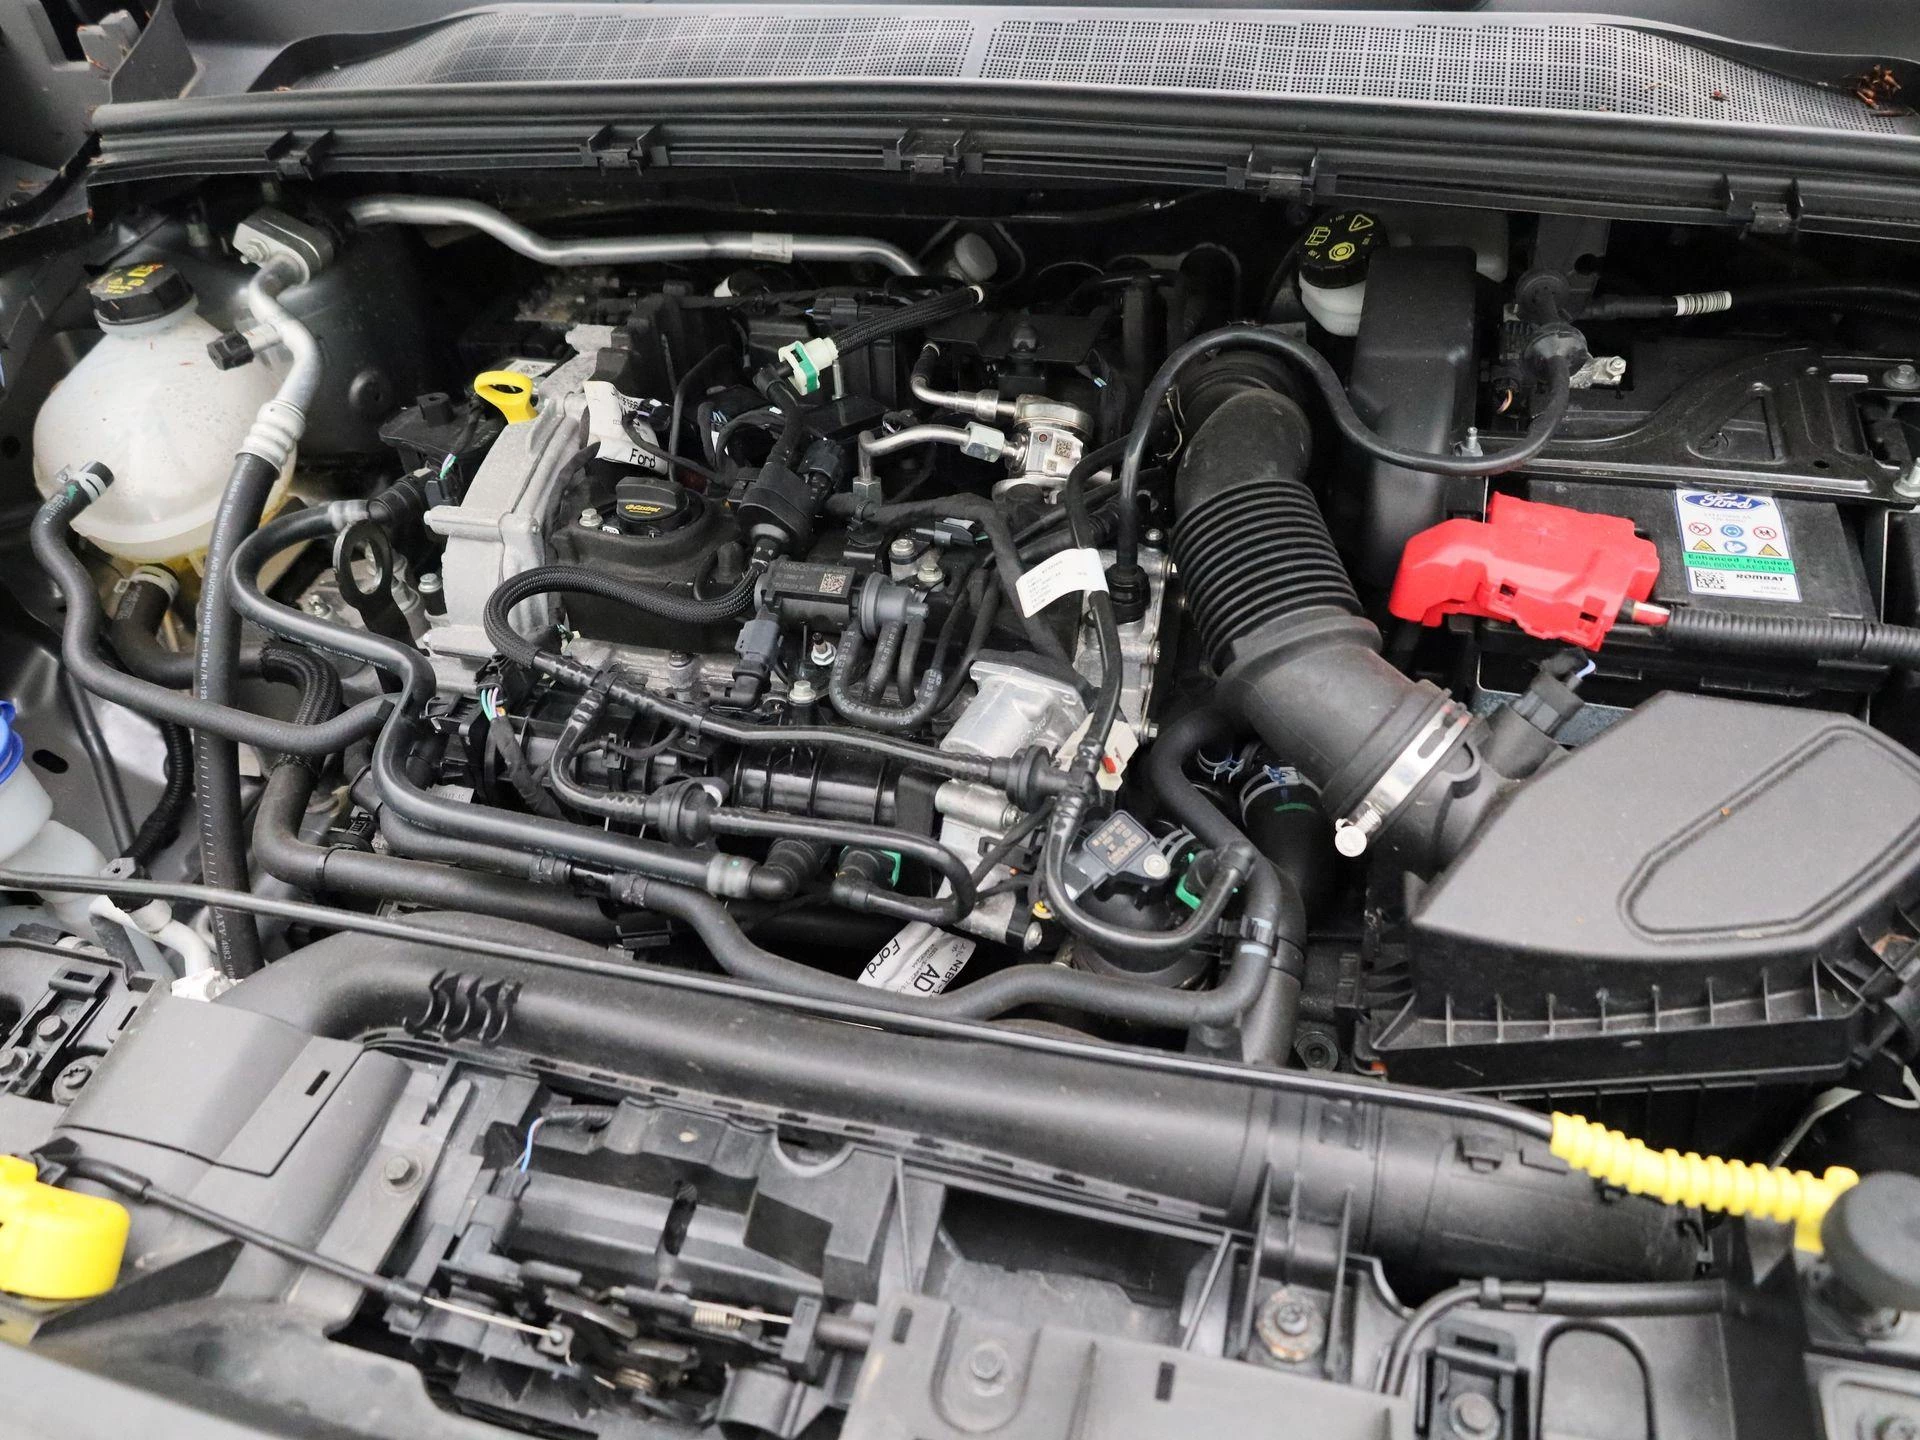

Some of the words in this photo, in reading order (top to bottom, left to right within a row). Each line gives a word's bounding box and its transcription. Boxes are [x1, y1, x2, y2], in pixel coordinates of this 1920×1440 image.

[629, 448, 657, 469] Ford
[1700, 492, 1752, 509] Ford
[1688, 553, 1740, 563] Enhanced
[1746, 557, 1790, 566] Flooded
[1736, 573, 1785, 582] ROMBAT
[206, 572, 217, 610] SUCTION
[203, 611, 214, 635] HOSE
[865, 938, 901, 979] Ford
[914, 963, 941, 993] AD
